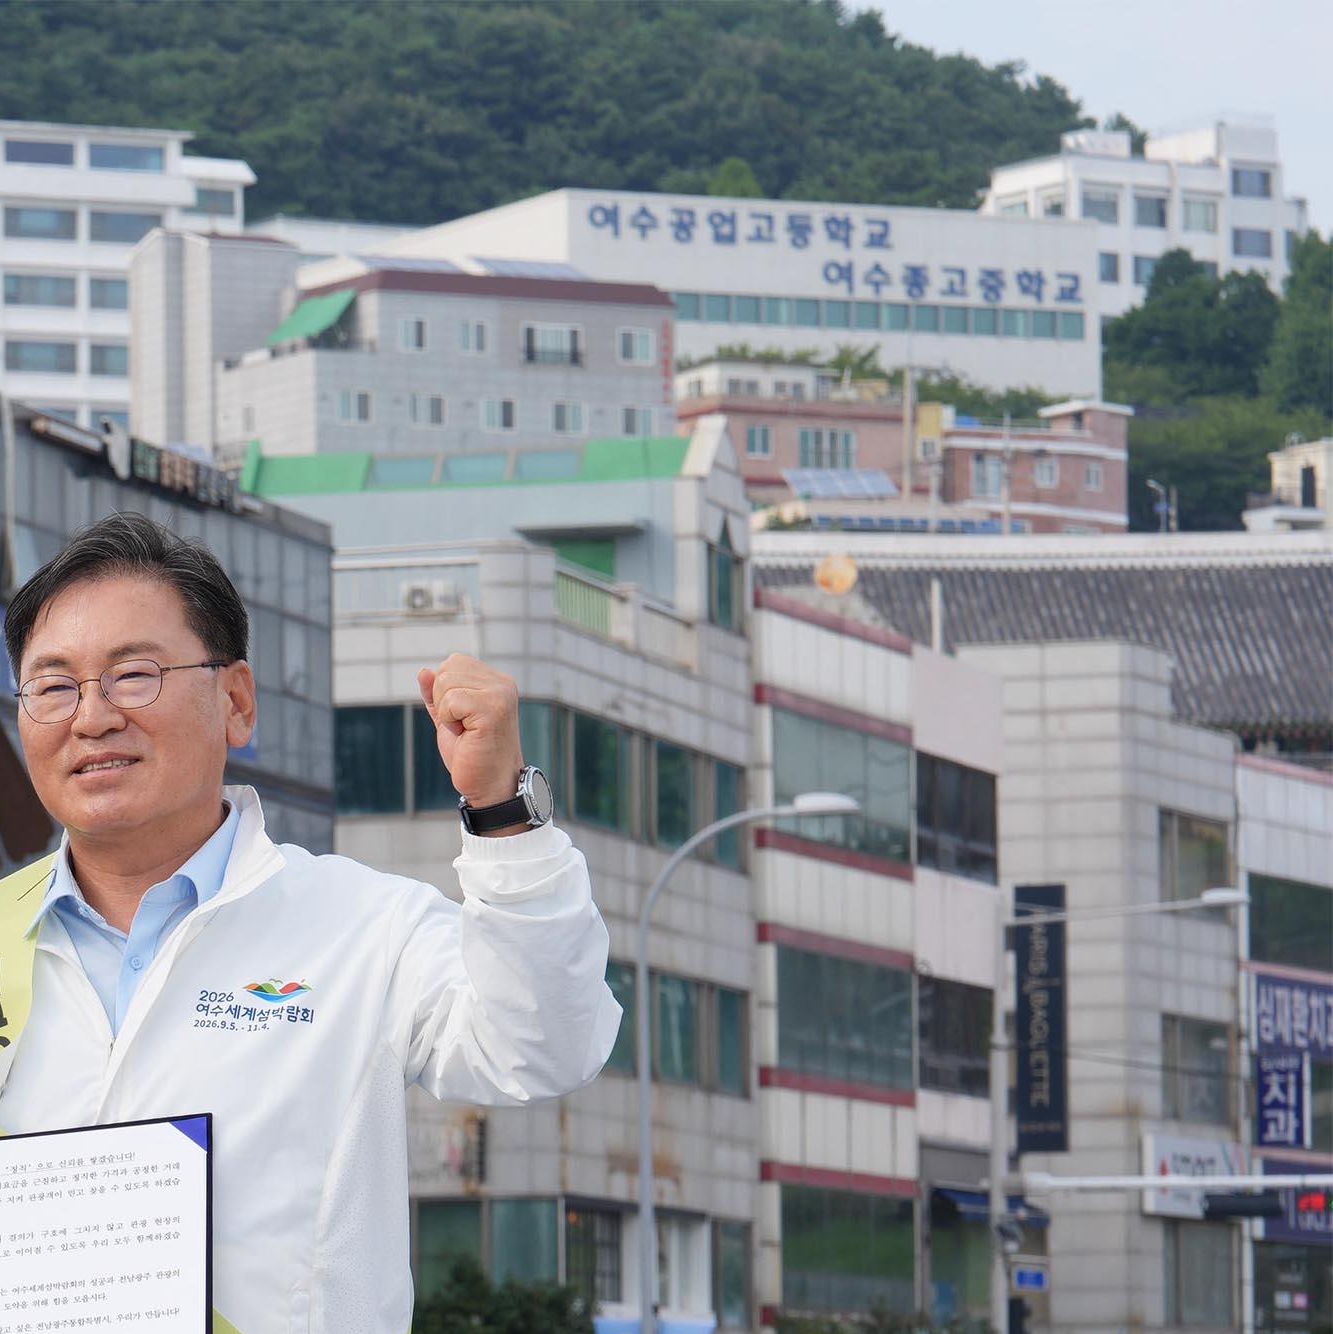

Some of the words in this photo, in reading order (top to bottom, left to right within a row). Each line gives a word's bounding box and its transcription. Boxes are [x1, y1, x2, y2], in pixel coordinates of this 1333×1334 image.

[588, 202, 894, 249] 여수공업고등학교
[822, 259, 1082, 304] 여수종고중학교
[199, 989, 235, 1003] 2026
[193, 1019, 239, 1031] 2026.9.5.
[195, 1003, 315, 1024] 여수세계섬박람회
[1262, 1071, 1300, 1146] 치과
